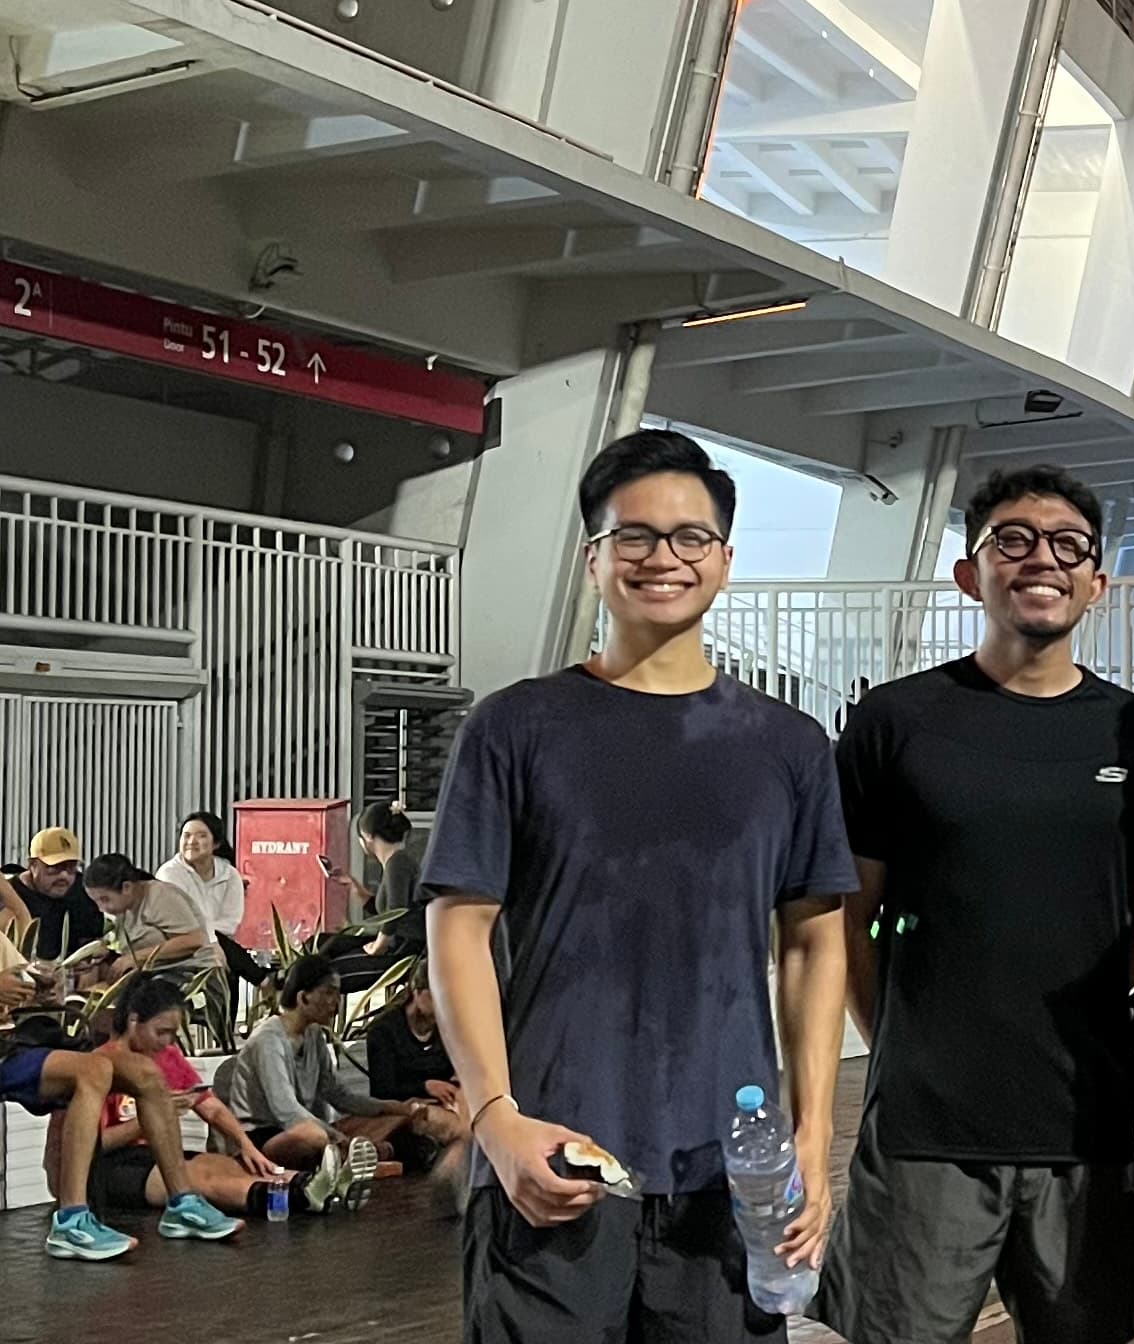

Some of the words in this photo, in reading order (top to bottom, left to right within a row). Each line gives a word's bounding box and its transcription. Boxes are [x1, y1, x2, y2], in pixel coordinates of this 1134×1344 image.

[202, 324, 229, 363] 51
[257, 338, 286, 376] 52
[251, 841, 310, 854] HYDRANT
